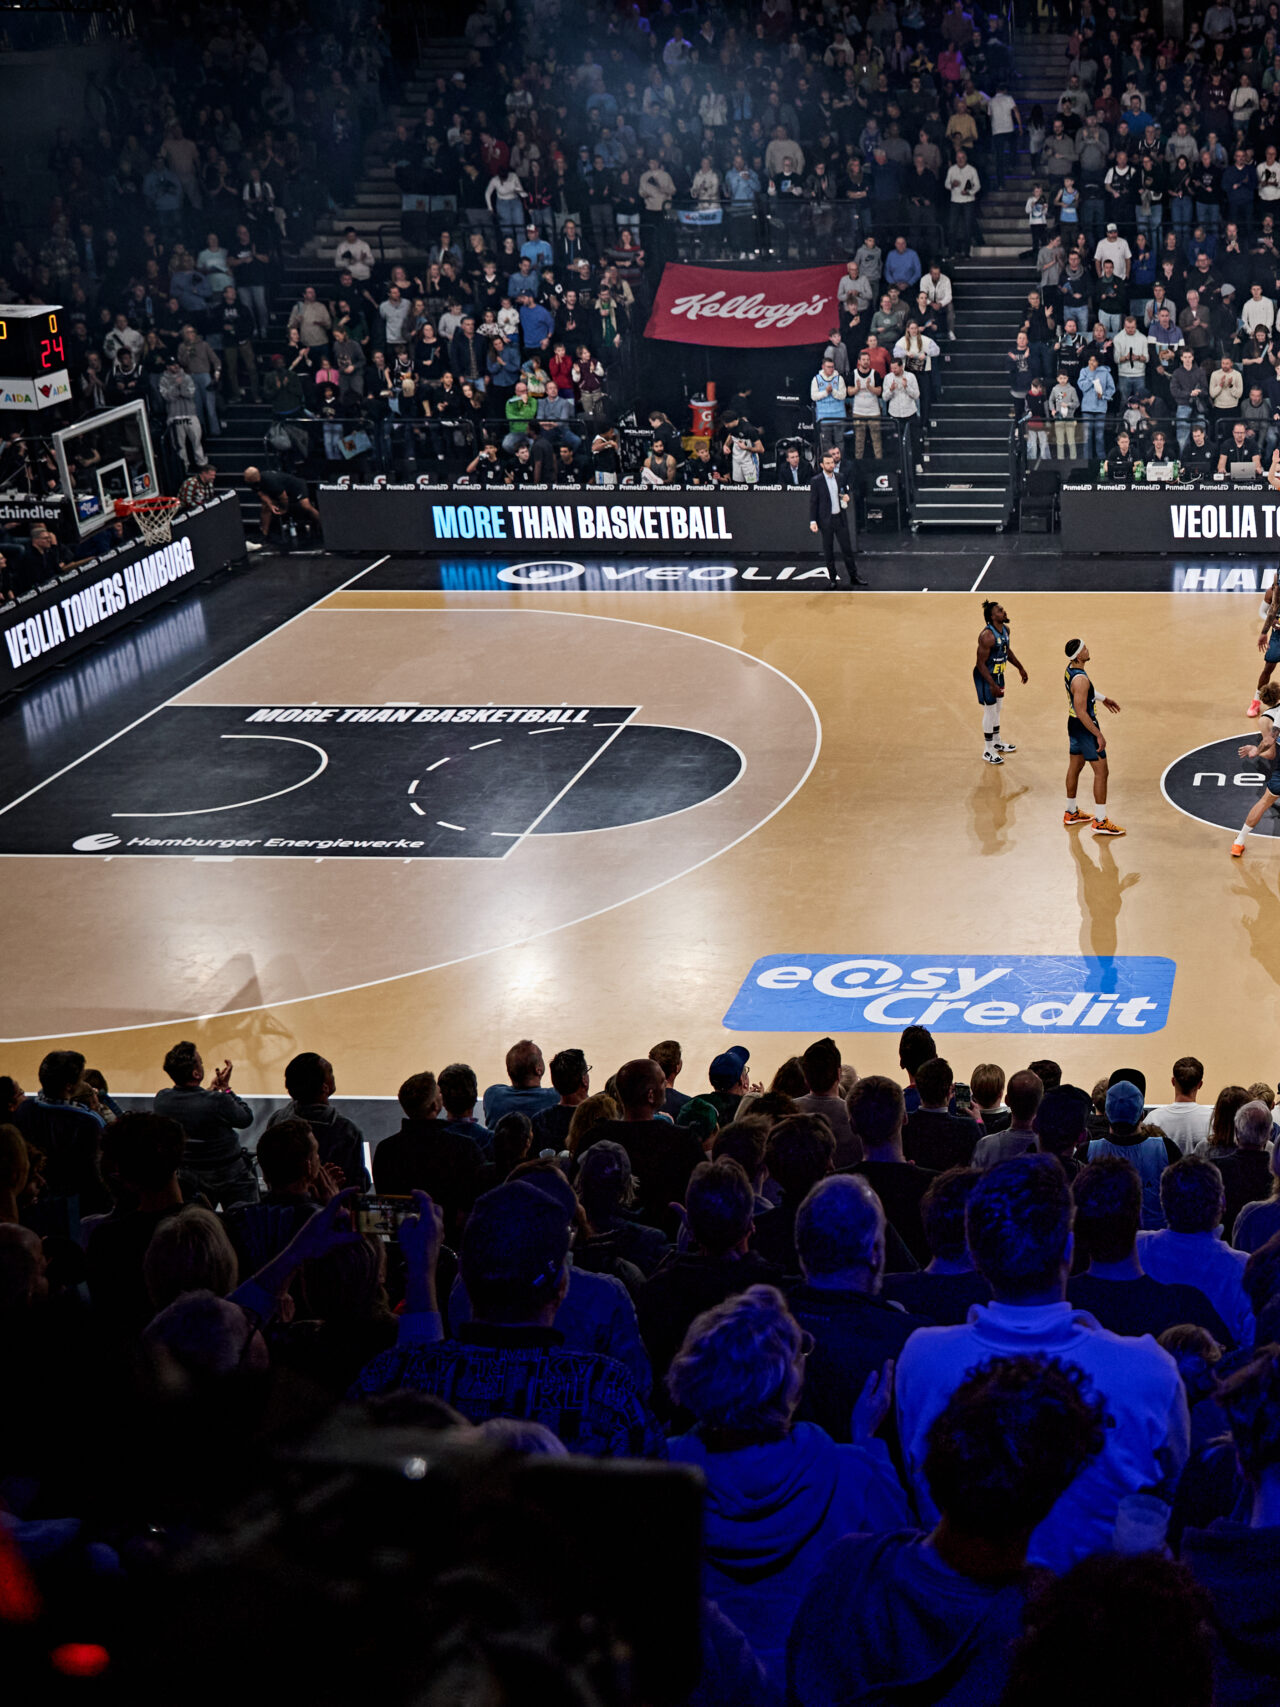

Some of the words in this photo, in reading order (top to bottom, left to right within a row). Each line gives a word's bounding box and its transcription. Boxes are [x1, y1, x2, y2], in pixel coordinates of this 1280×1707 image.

[49, 314, 57, 333] 0
[670, 291, 829, 328] Kellogg's
[41, 336, 64, 368] 24
[4, 393, 32, 403] AIDA
[53, 384, 68, 396] AIDA
[432, 506, 507, 539] MORE
[508, 506, 574, 539] THAN
[577, 506, 733, 539] BASKETBALL
[1171, 505, 1257, 538] VEOLIA
[602, 566, 840, 580] VEOLIA
[4, 605, 66, 669] VEOLIA
[61, 572, 126, 638] TOWERS
[123, 536, 195, 604] HAMBURG
[245, 708, 340, 723] MORE
[335, 708, 415, 723] THAN
[411, 709, 588, 723] BASKETBALL
[126, 836, 262, 849] Hamburger
[264, 837, 425, 849] Energiewerke
[755, 959, 1014, 1000] e@sy
[863, 991, 1158, 1028] Credit
